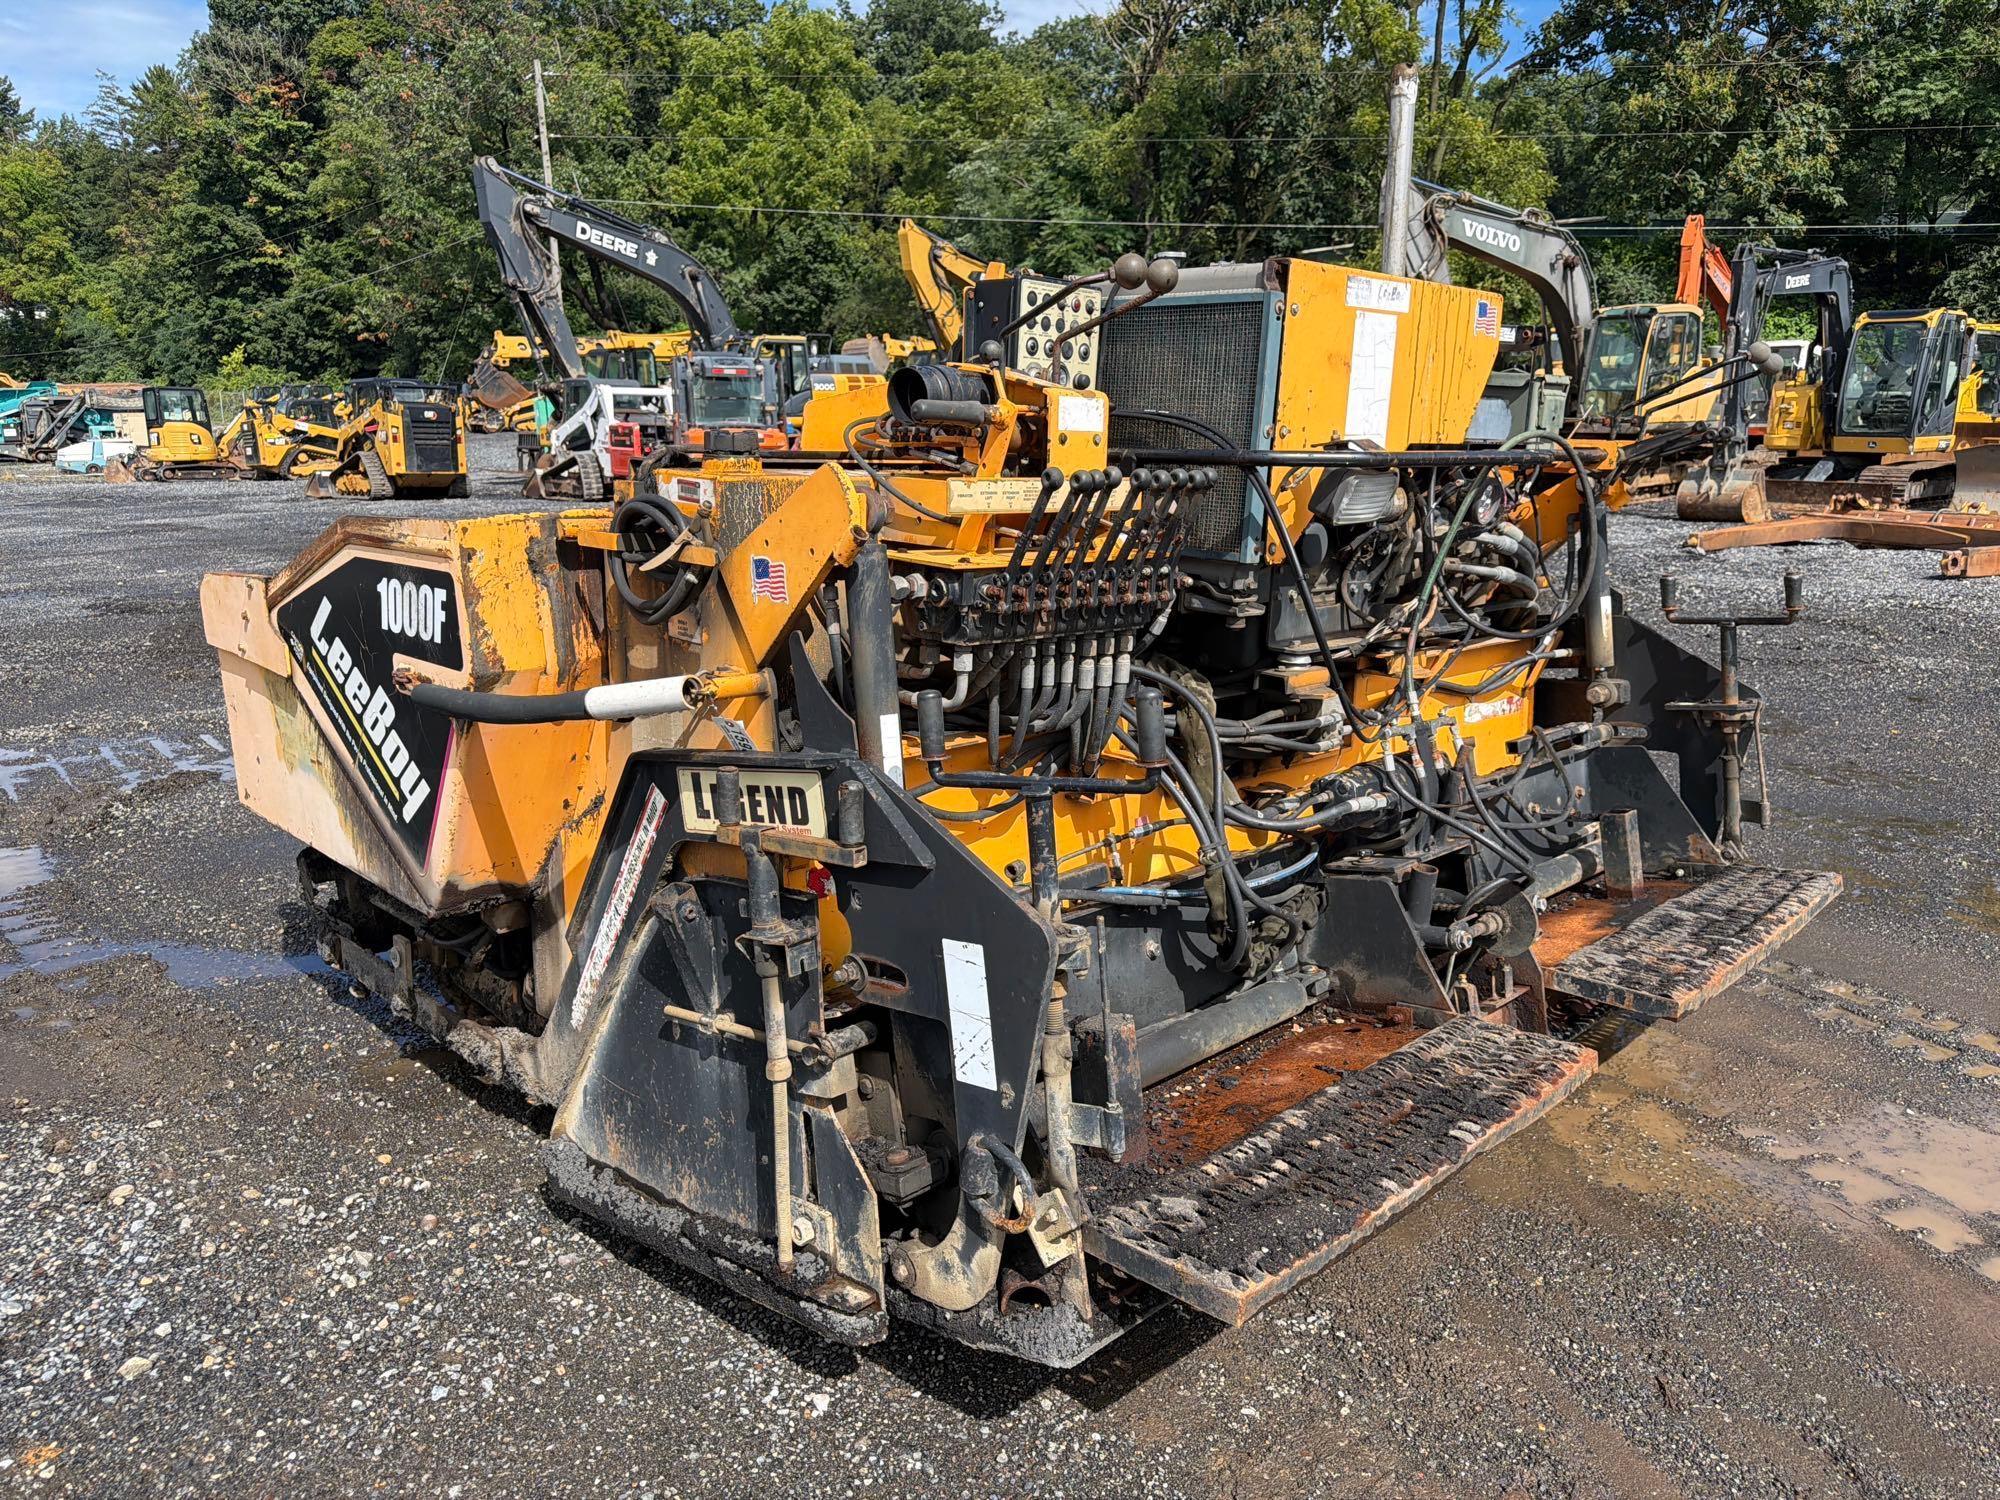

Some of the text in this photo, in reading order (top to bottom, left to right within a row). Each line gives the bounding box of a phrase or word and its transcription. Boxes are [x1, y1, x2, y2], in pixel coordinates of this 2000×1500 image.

[575, 220, 638, 258] DEERE
[1462, 218, 1520, 252] VOLVO
[1785, 274, 1810, 289] DEERE
[377, 577, 446, 644] 1000F
[310, 595, 430, 824] LeeBoy
[691, 772, 809, 825] LEND
